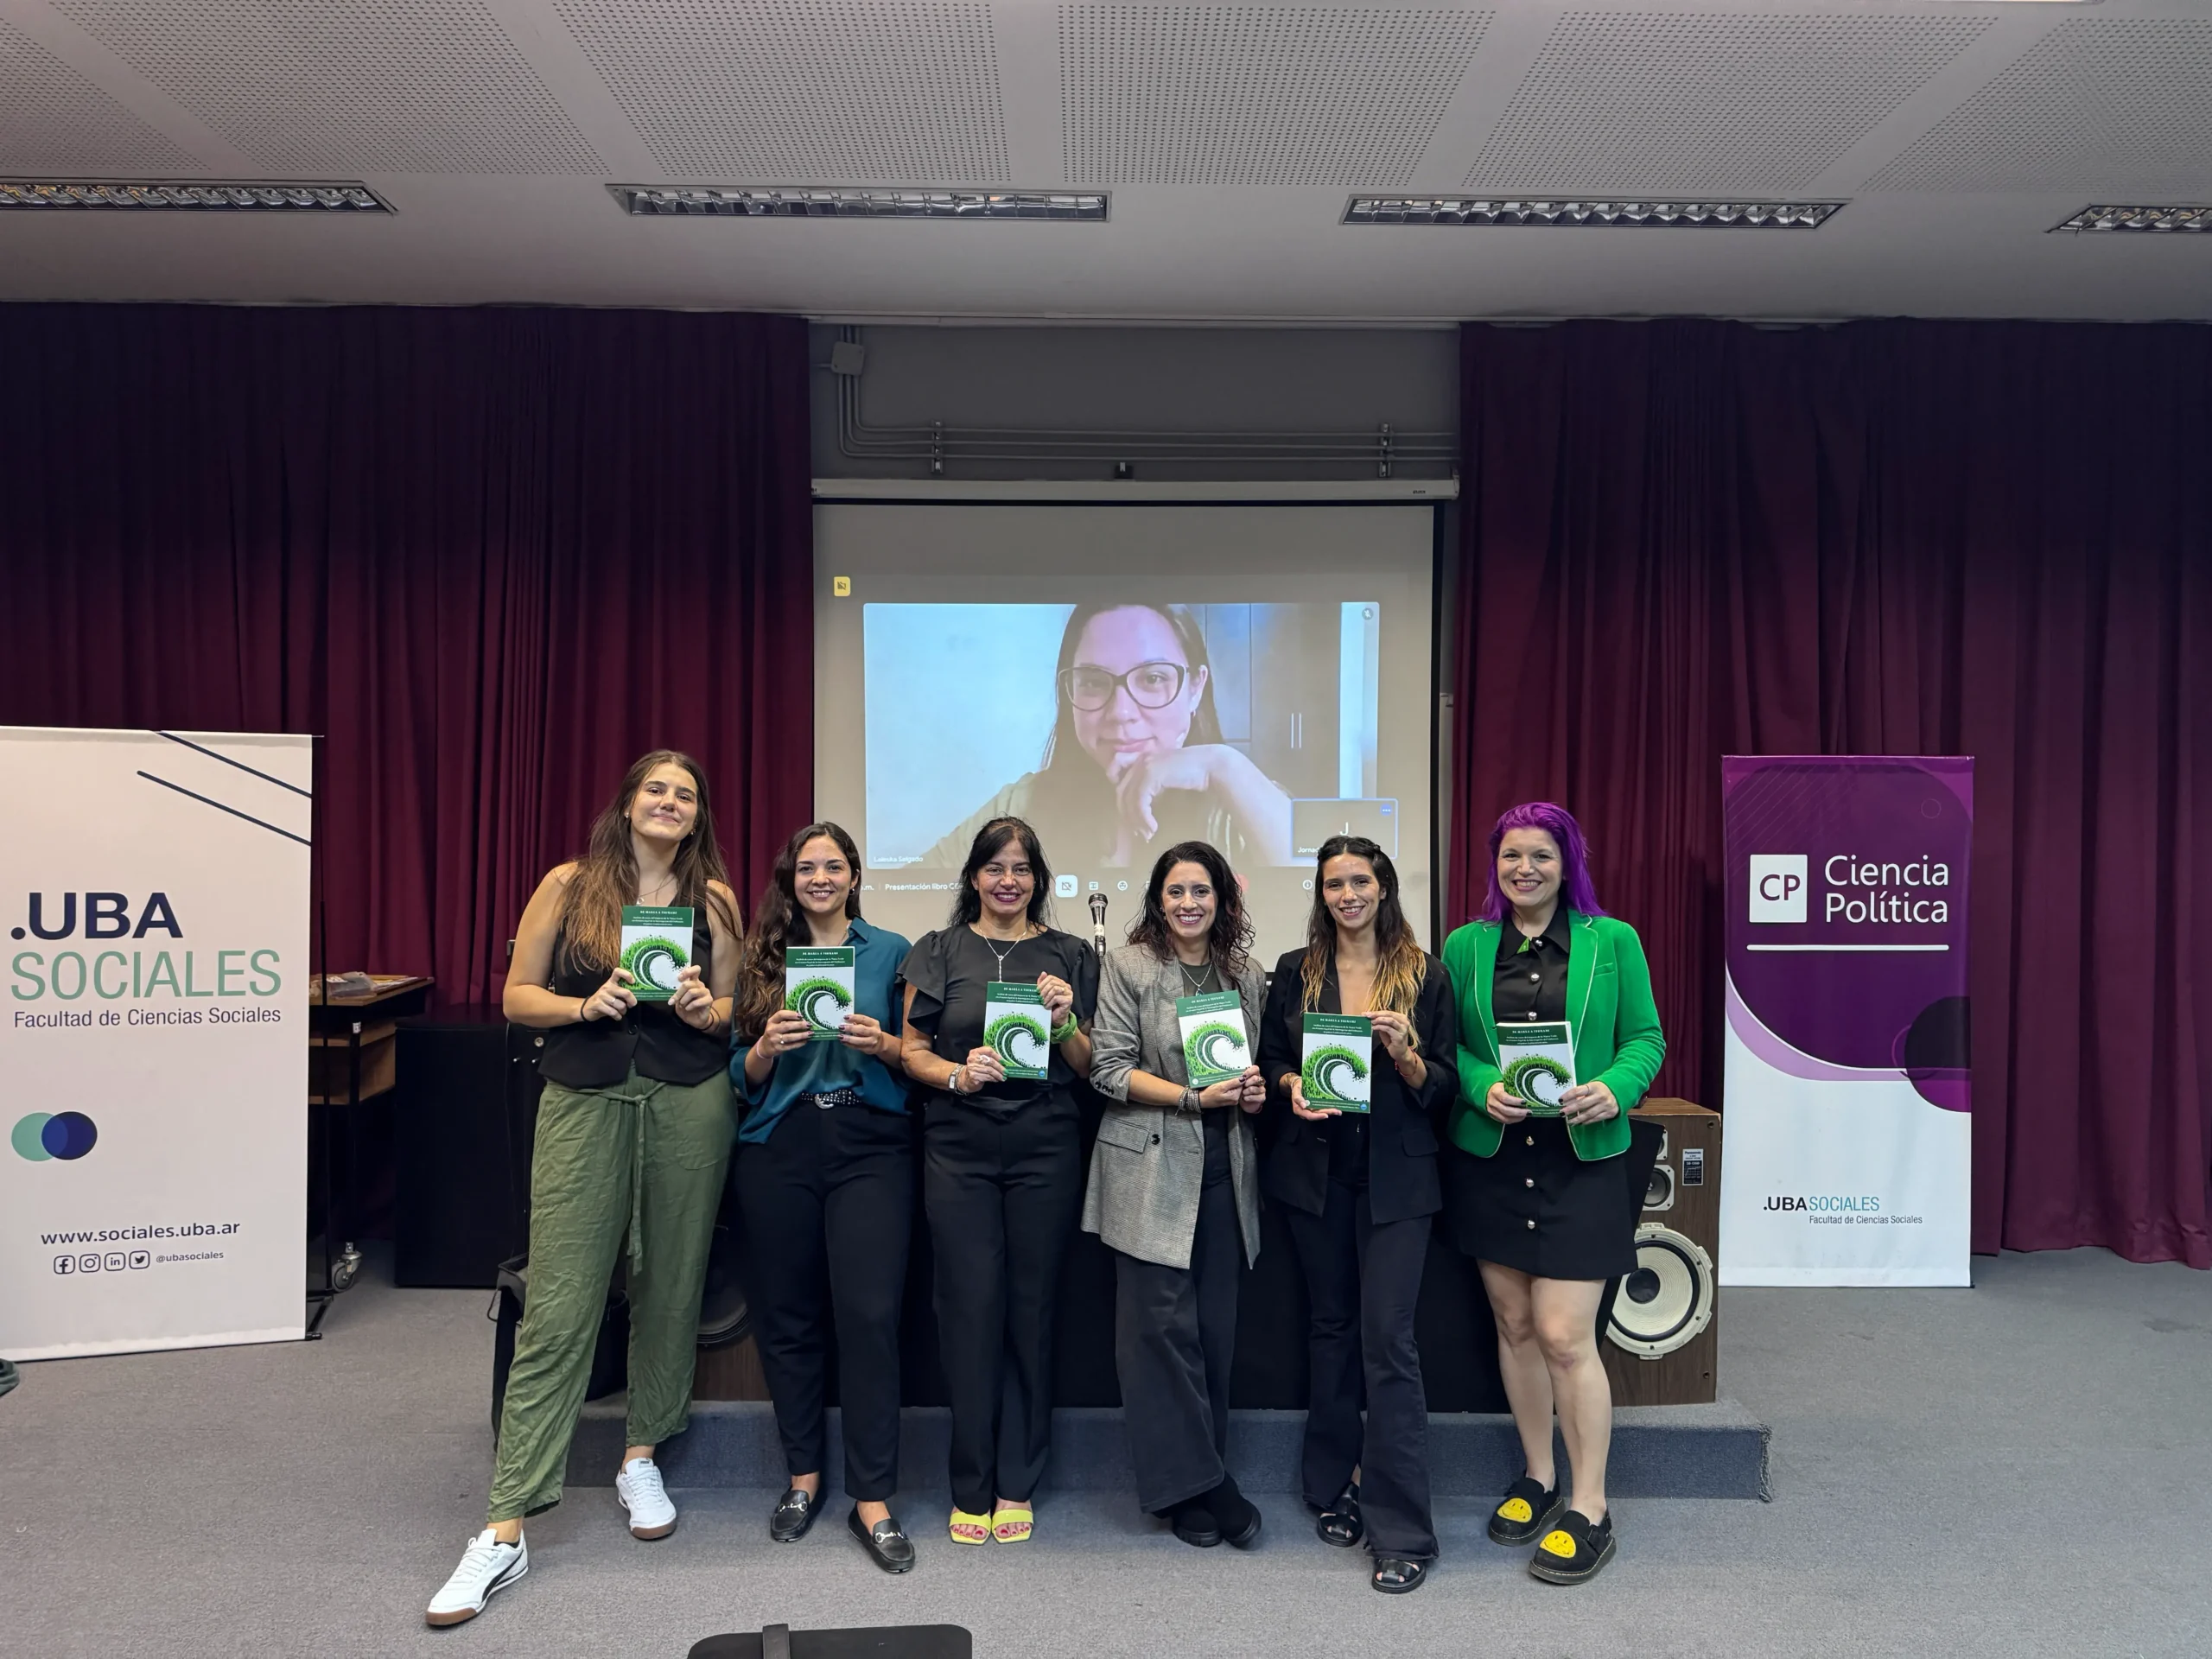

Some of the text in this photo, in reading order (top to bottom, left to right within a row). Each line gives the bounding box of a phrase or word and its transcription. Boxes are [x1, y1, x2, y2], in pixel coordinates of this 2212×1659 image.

[1339, 822, 1349, 836] J
[1825, 855, 1949, 887] Ciencia
[885, 882, 930, 891] Presentación
[1759, 874, 1801, 901] CP
[10, 892, 184, 940] .UBA
[1826, 891, 1948, 924] Política
[10, 949, 282, 1001] SOCIALES
[14, 1006, 282, 1028] Facultad de Ciencias Sociales
[1809, 1215, 1923, 1224] Facultad de Ciencias Sociales
[41, 1222, 240, 1245] www.sociales.uba.ar
[156, 1251, 225, 1263] @ubasociales
